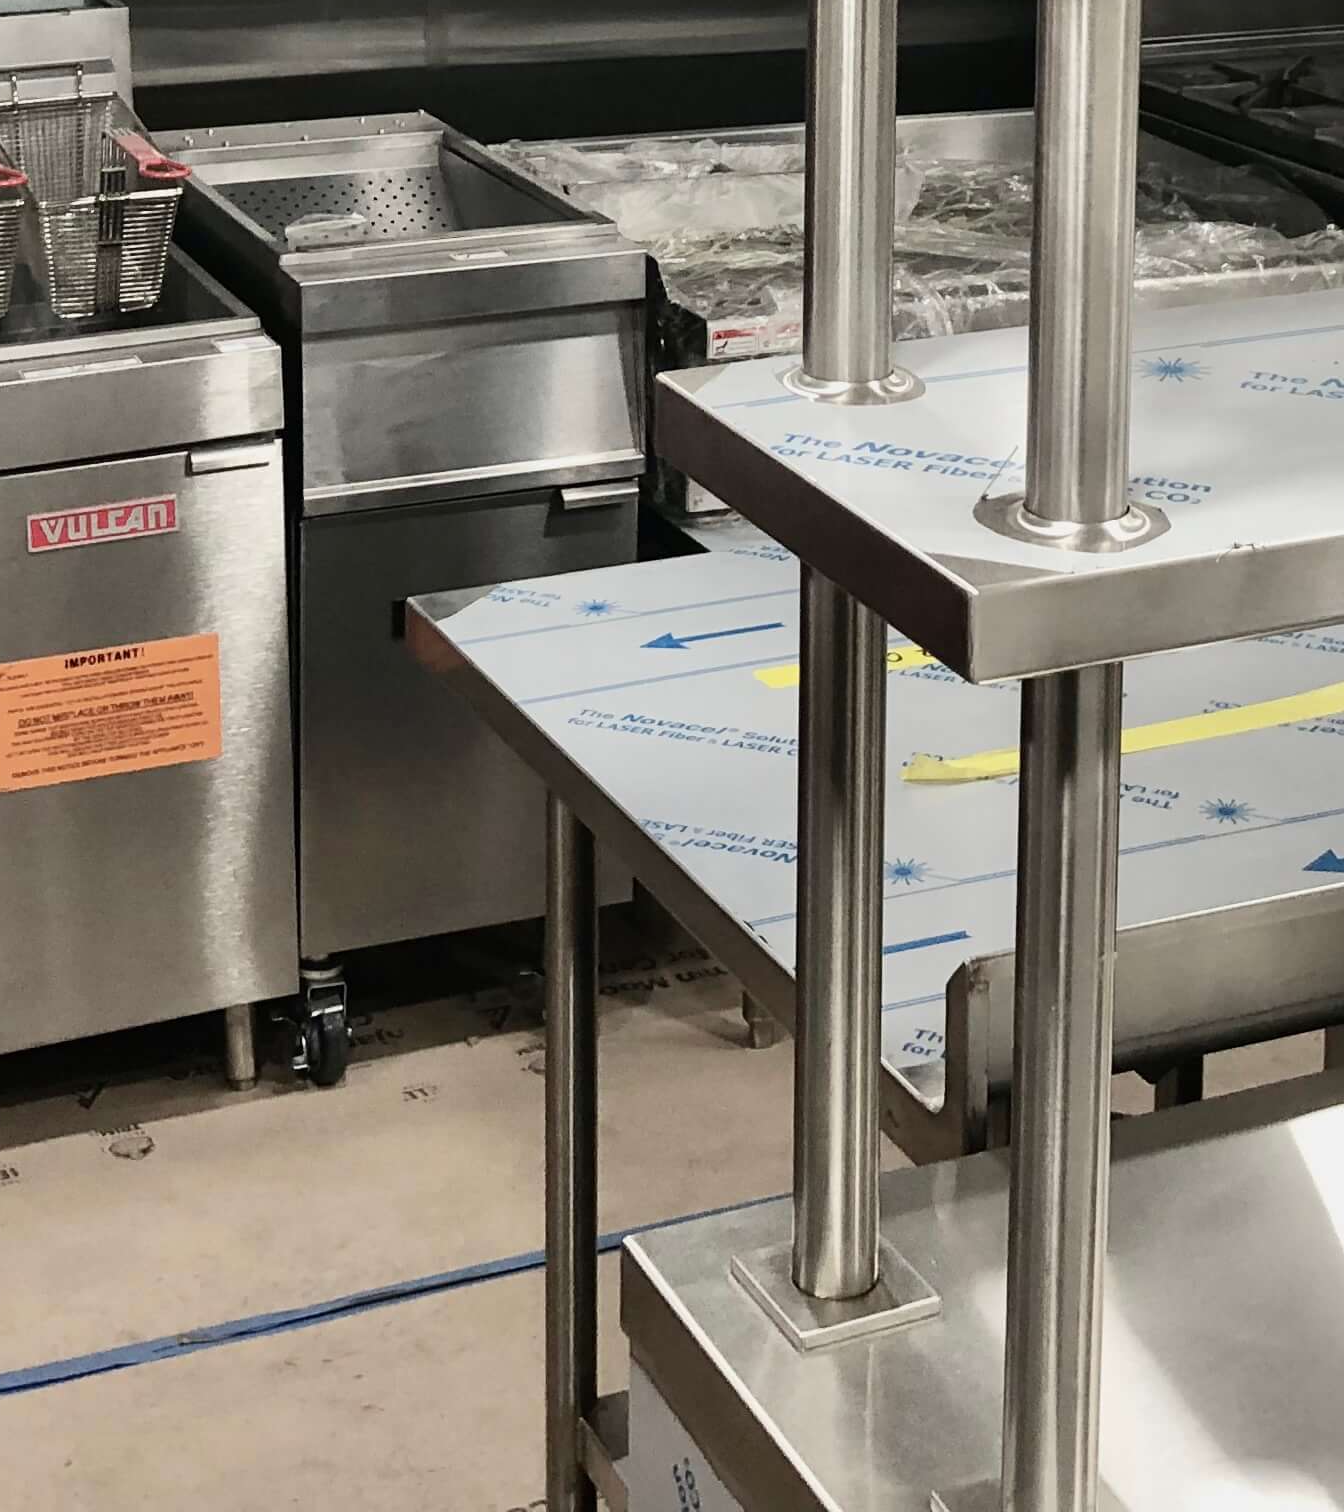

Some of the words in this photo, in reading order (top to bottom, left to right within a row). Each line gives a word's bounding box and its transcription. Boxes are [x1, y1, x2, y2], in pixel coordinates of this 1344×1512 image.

[1249, 370, 1309, 385] The
[1239, 380, 1284, 393] for
[784, 432, 842, 449] The
[815, 449, 914, 471] LASER
[922, 462, 1001, 481] Fiber
[39, 502, 168, 544] VULCAN
[579, 707, 616, 720] The
[741, 730, 798, 746] Solut
[567, 716, 595, 727] for
[596, 720, 654, 736] LASER
[658, 728, 706, 743] Fiber
[721, 737, 782, 755] LASER
[706, 828, 757, 845] Fiber
[914, 1027, 944, 1044] Th
[901, 1041, 937, 1057] for
